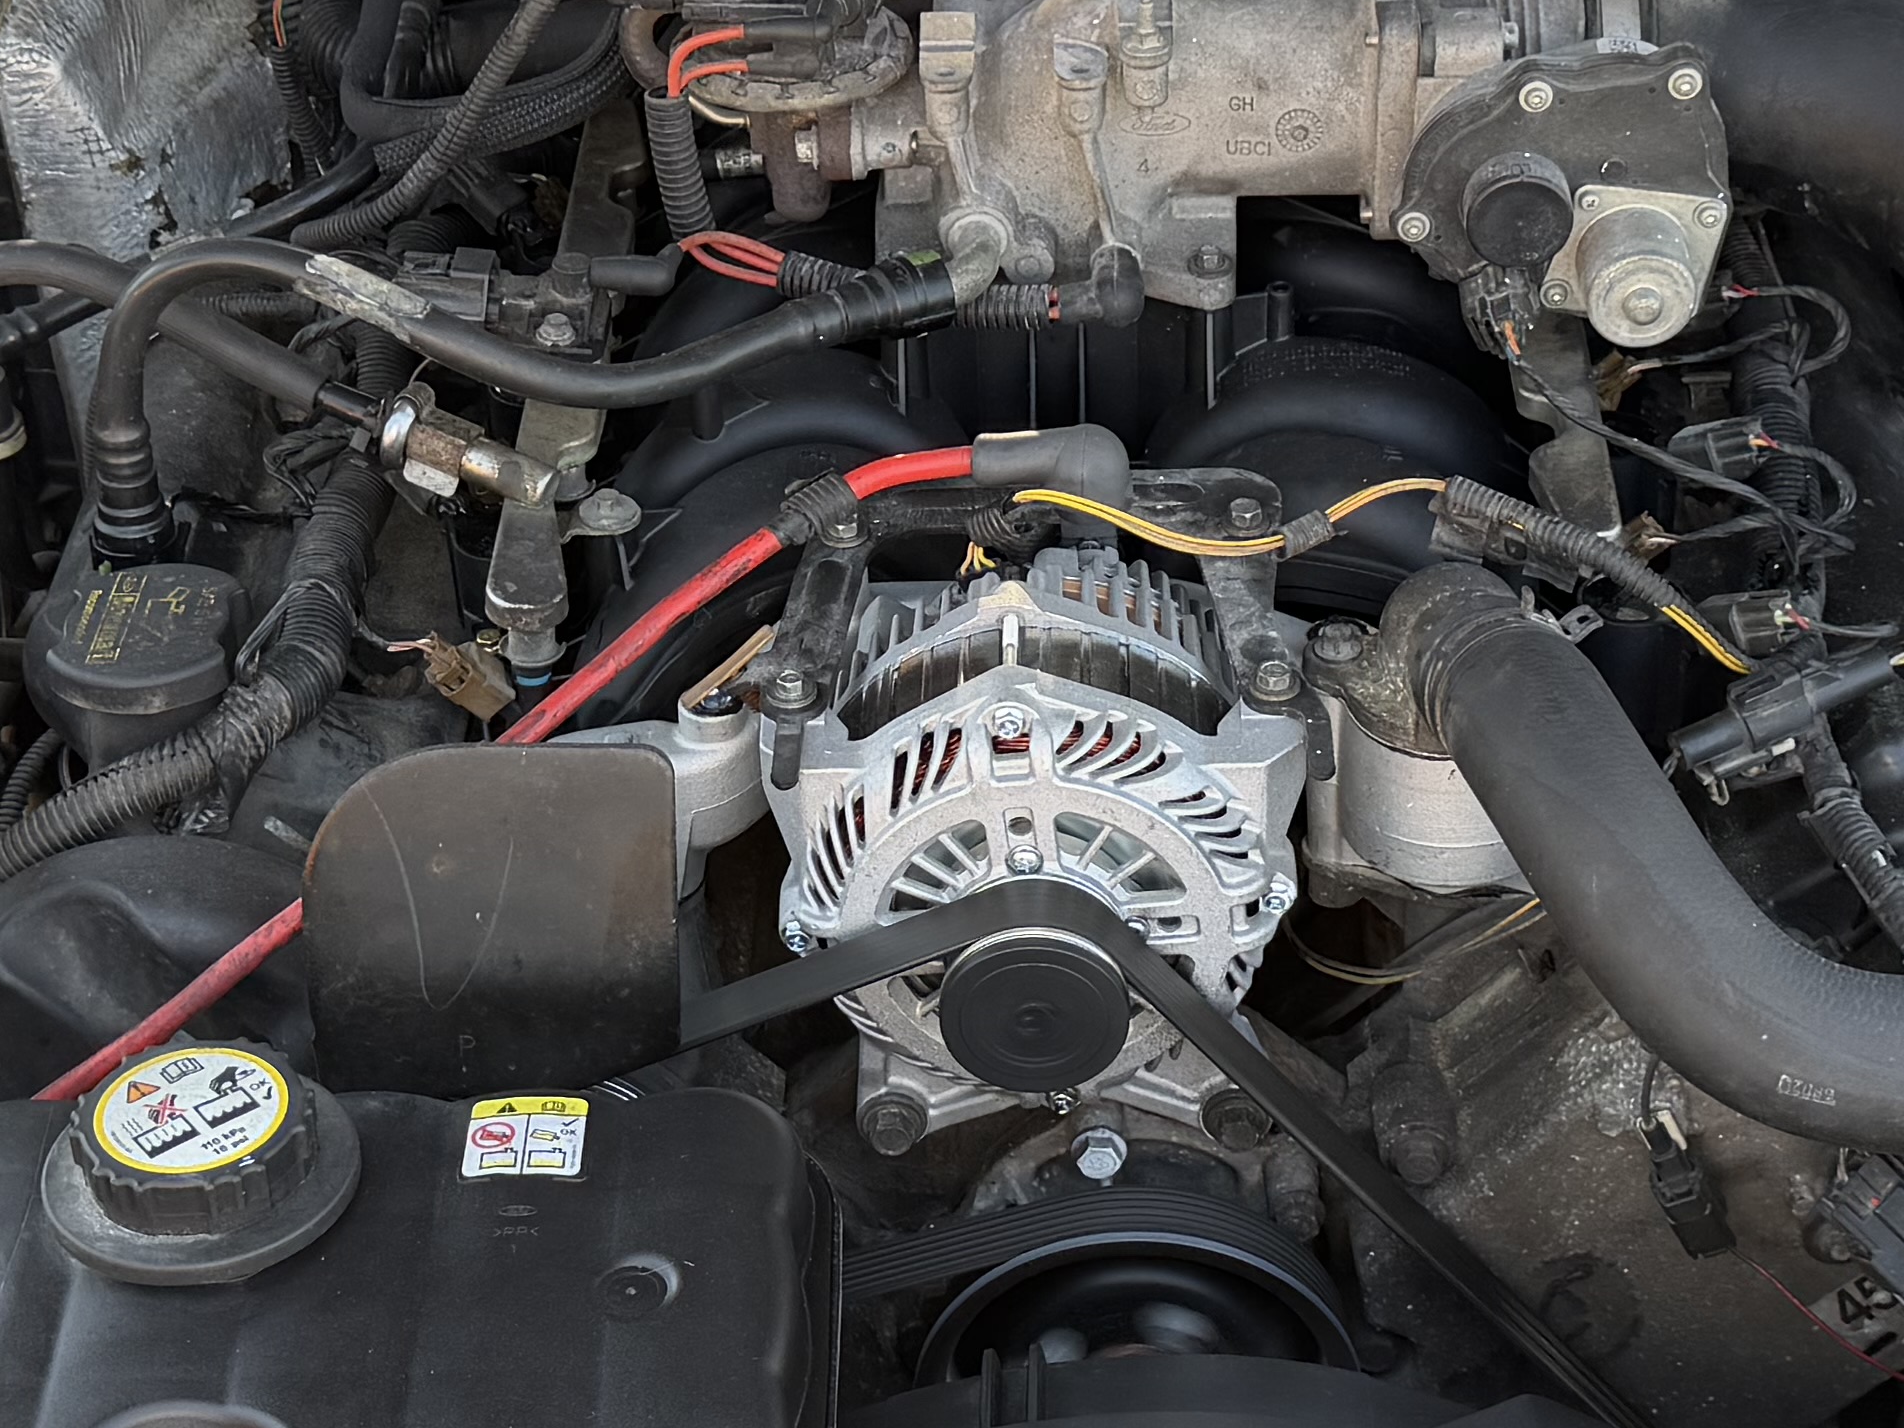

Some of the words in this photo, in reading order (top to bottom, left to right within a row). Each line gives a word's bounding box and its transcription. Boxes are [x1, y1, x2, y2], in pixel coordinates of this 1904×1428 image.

[1228, 96, 1254, 112] GH
[249, 1078, 272, 1091] OK
[201, 1137, 221, 1151] 110
